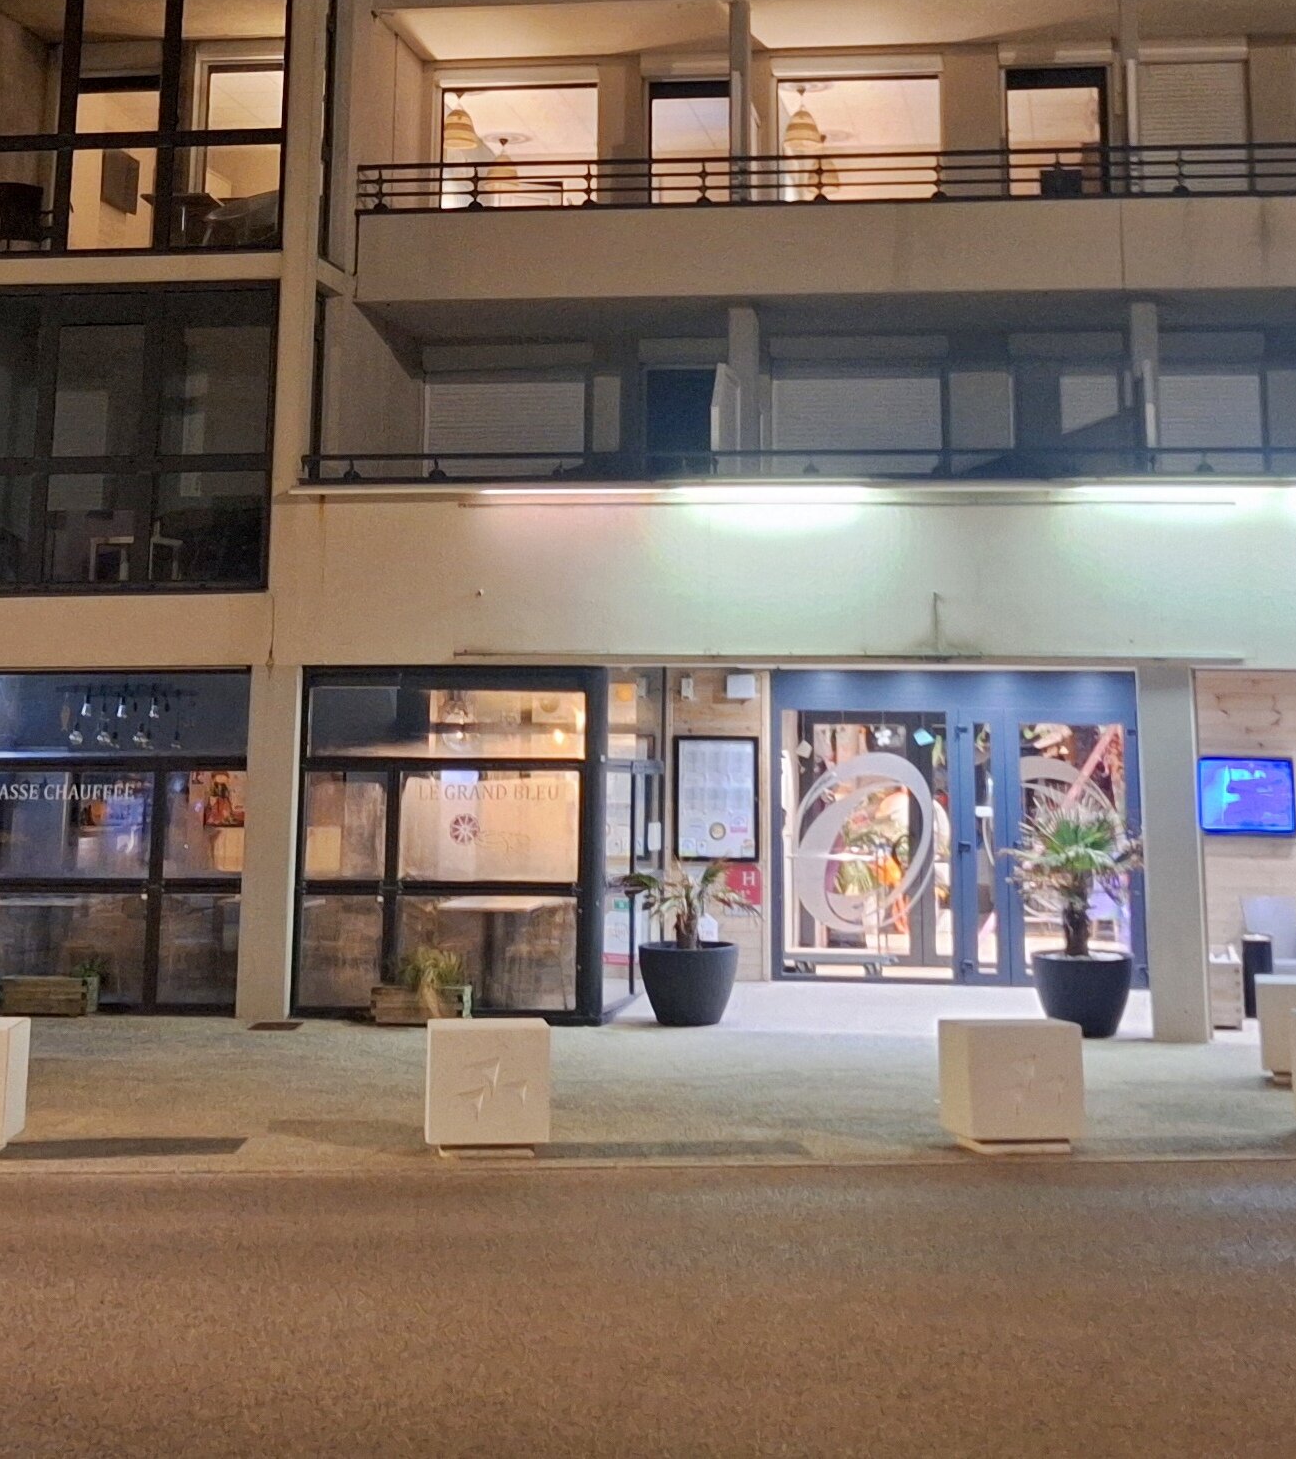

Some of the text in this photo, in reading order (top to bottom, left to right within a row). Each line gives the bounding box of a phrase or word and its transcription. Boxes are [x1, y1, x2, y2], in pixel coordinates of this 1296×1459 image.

[418, 783, 560, 801] LE GRAND BLEU
[741, 871, 756, 887] H
